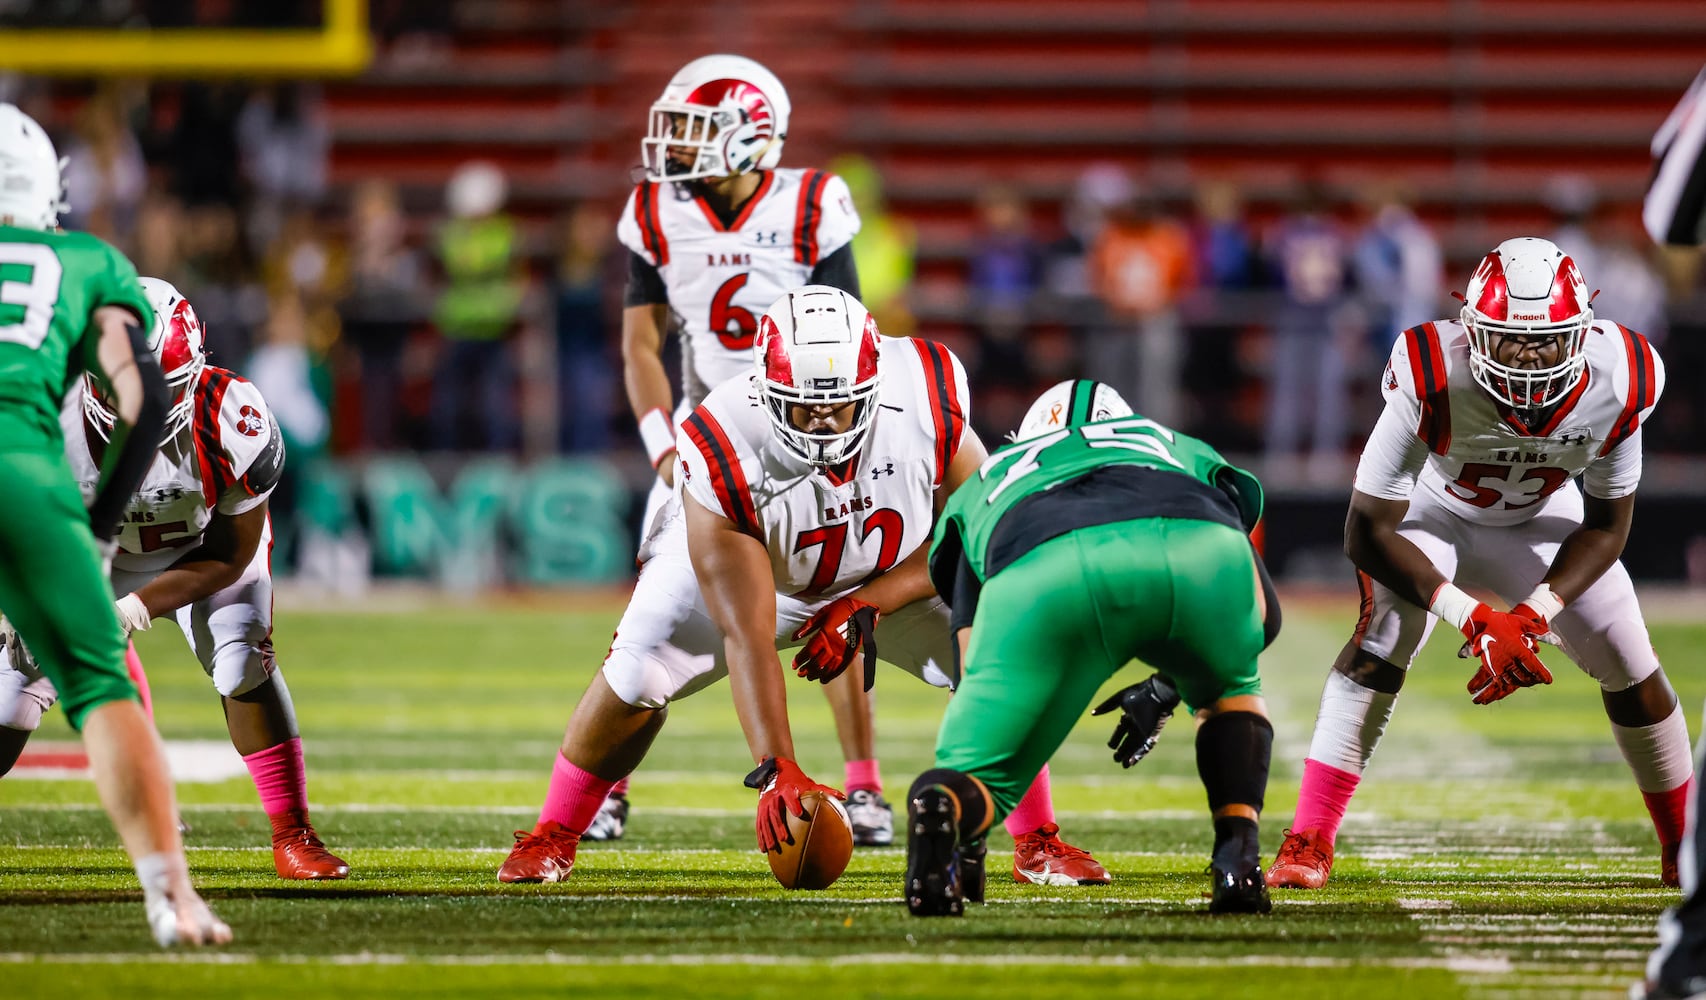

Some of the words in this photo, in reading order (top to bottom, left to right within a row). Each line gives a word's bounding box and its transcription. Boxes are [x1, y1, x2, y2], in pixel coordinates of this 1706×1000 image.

[707, 253, 752, 266] RAMS
[708, 272, 758, 351] 6
[1512, 313, 1546, 321] Riddell
[978, 418, 1186, 505] 75
[1496, 451, 1548, 463] RAMS
[1444, 462, 1570, 510] 53
[121, 511, 156, 523] AMS
[825, 496, 873, 521] RAMS
[791, 507, 904, 597] 72
